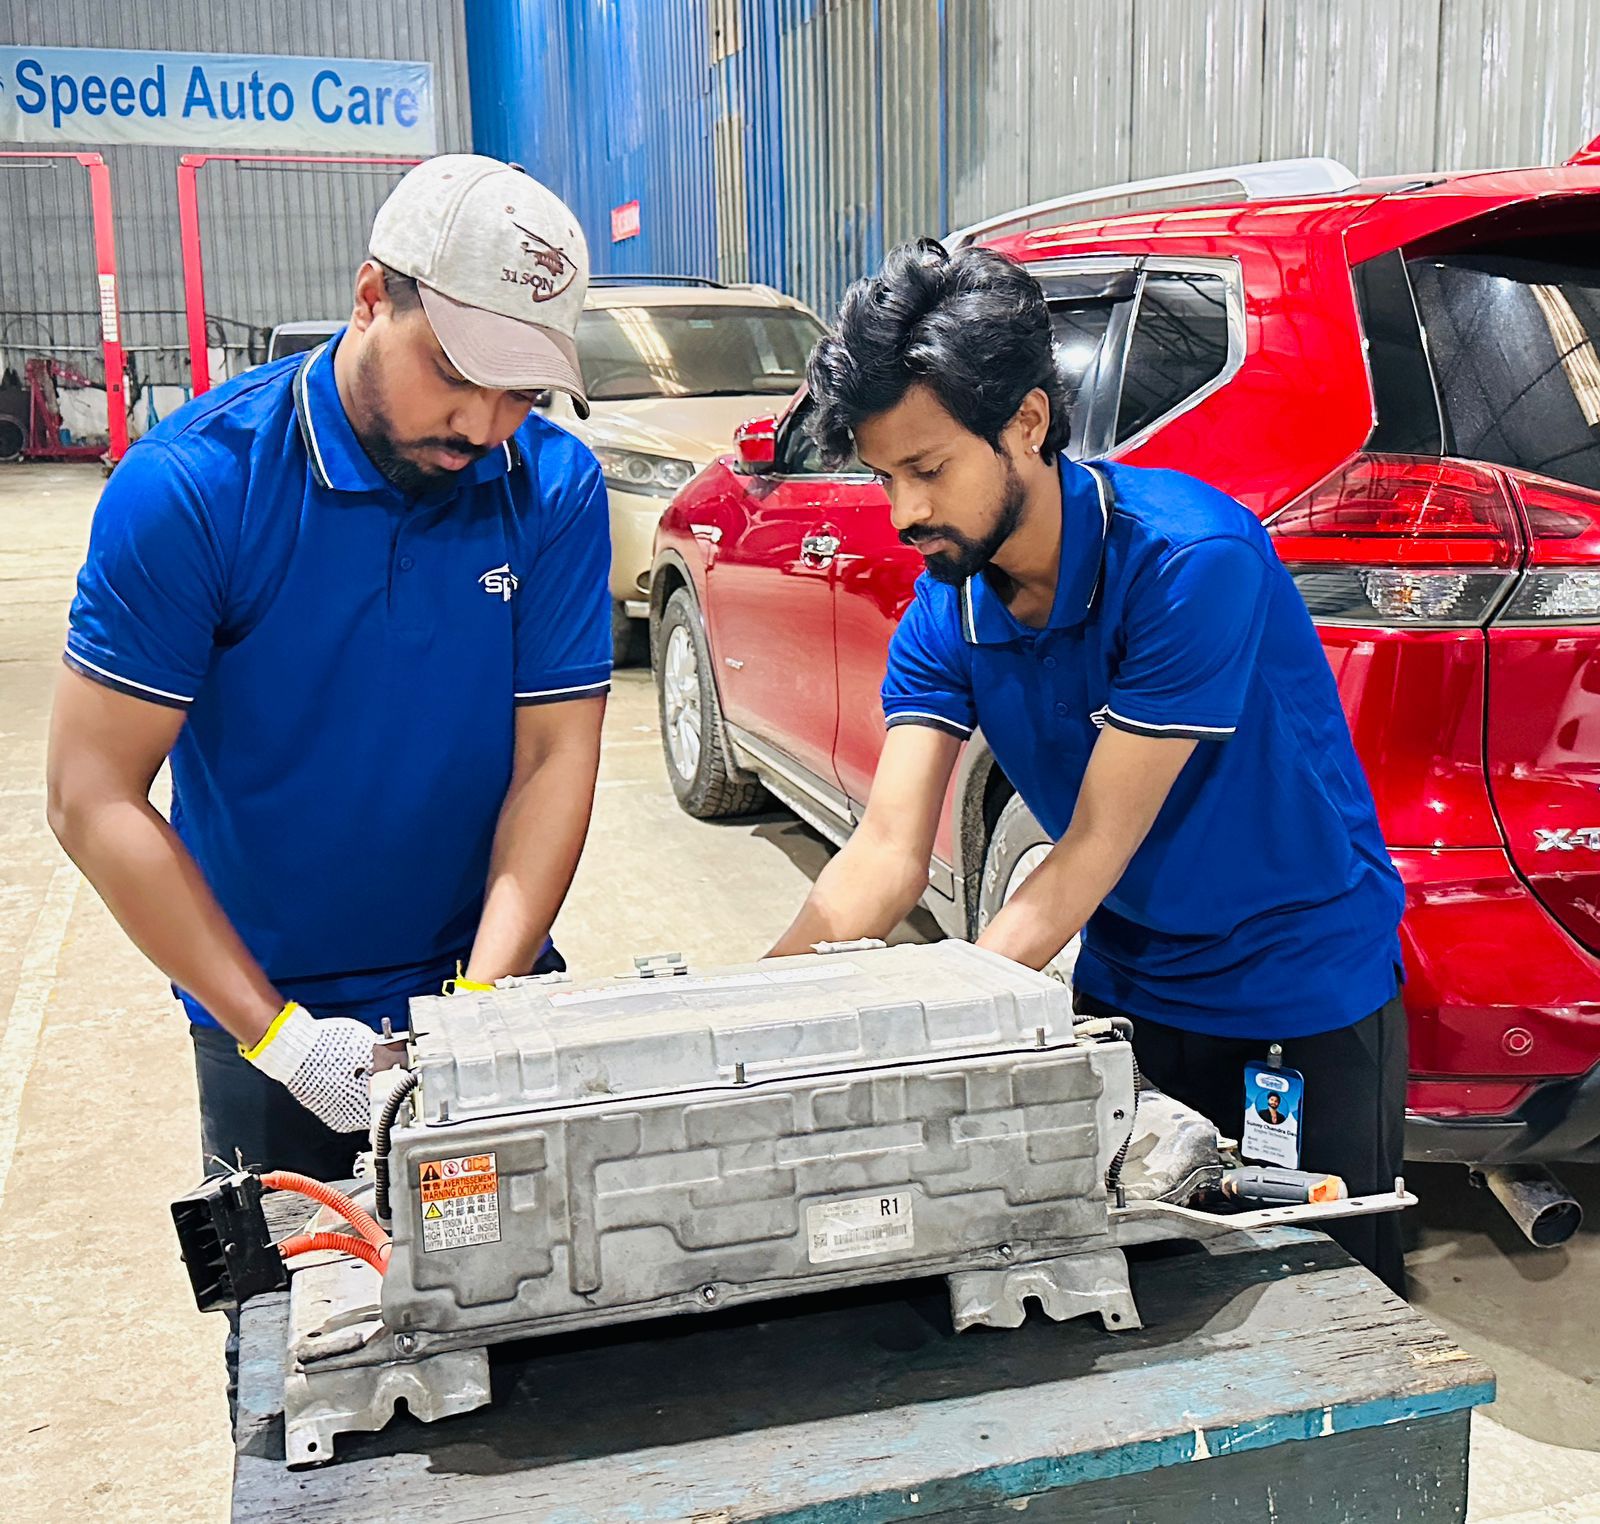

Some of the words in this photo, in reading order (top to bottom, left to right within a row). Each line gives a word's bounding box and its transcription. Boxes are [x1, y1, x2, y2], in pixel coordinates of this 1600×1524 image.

[15, 59, 167, 129] Speed
[182, 65, 295, 122] Auto
[311, 69, 419, 129] Care
[443, 1174, 495, 1188] AVERTISSEMENT
[423, 1188, 456, 1200] WARNING
[880, 1197, 898, 1216] R1
[425, 1232, 441, 1242] HIGH
[444, 1225, 474, 1239] VOLTAGE
[477, 1221, 498, 1233] INSIDE
